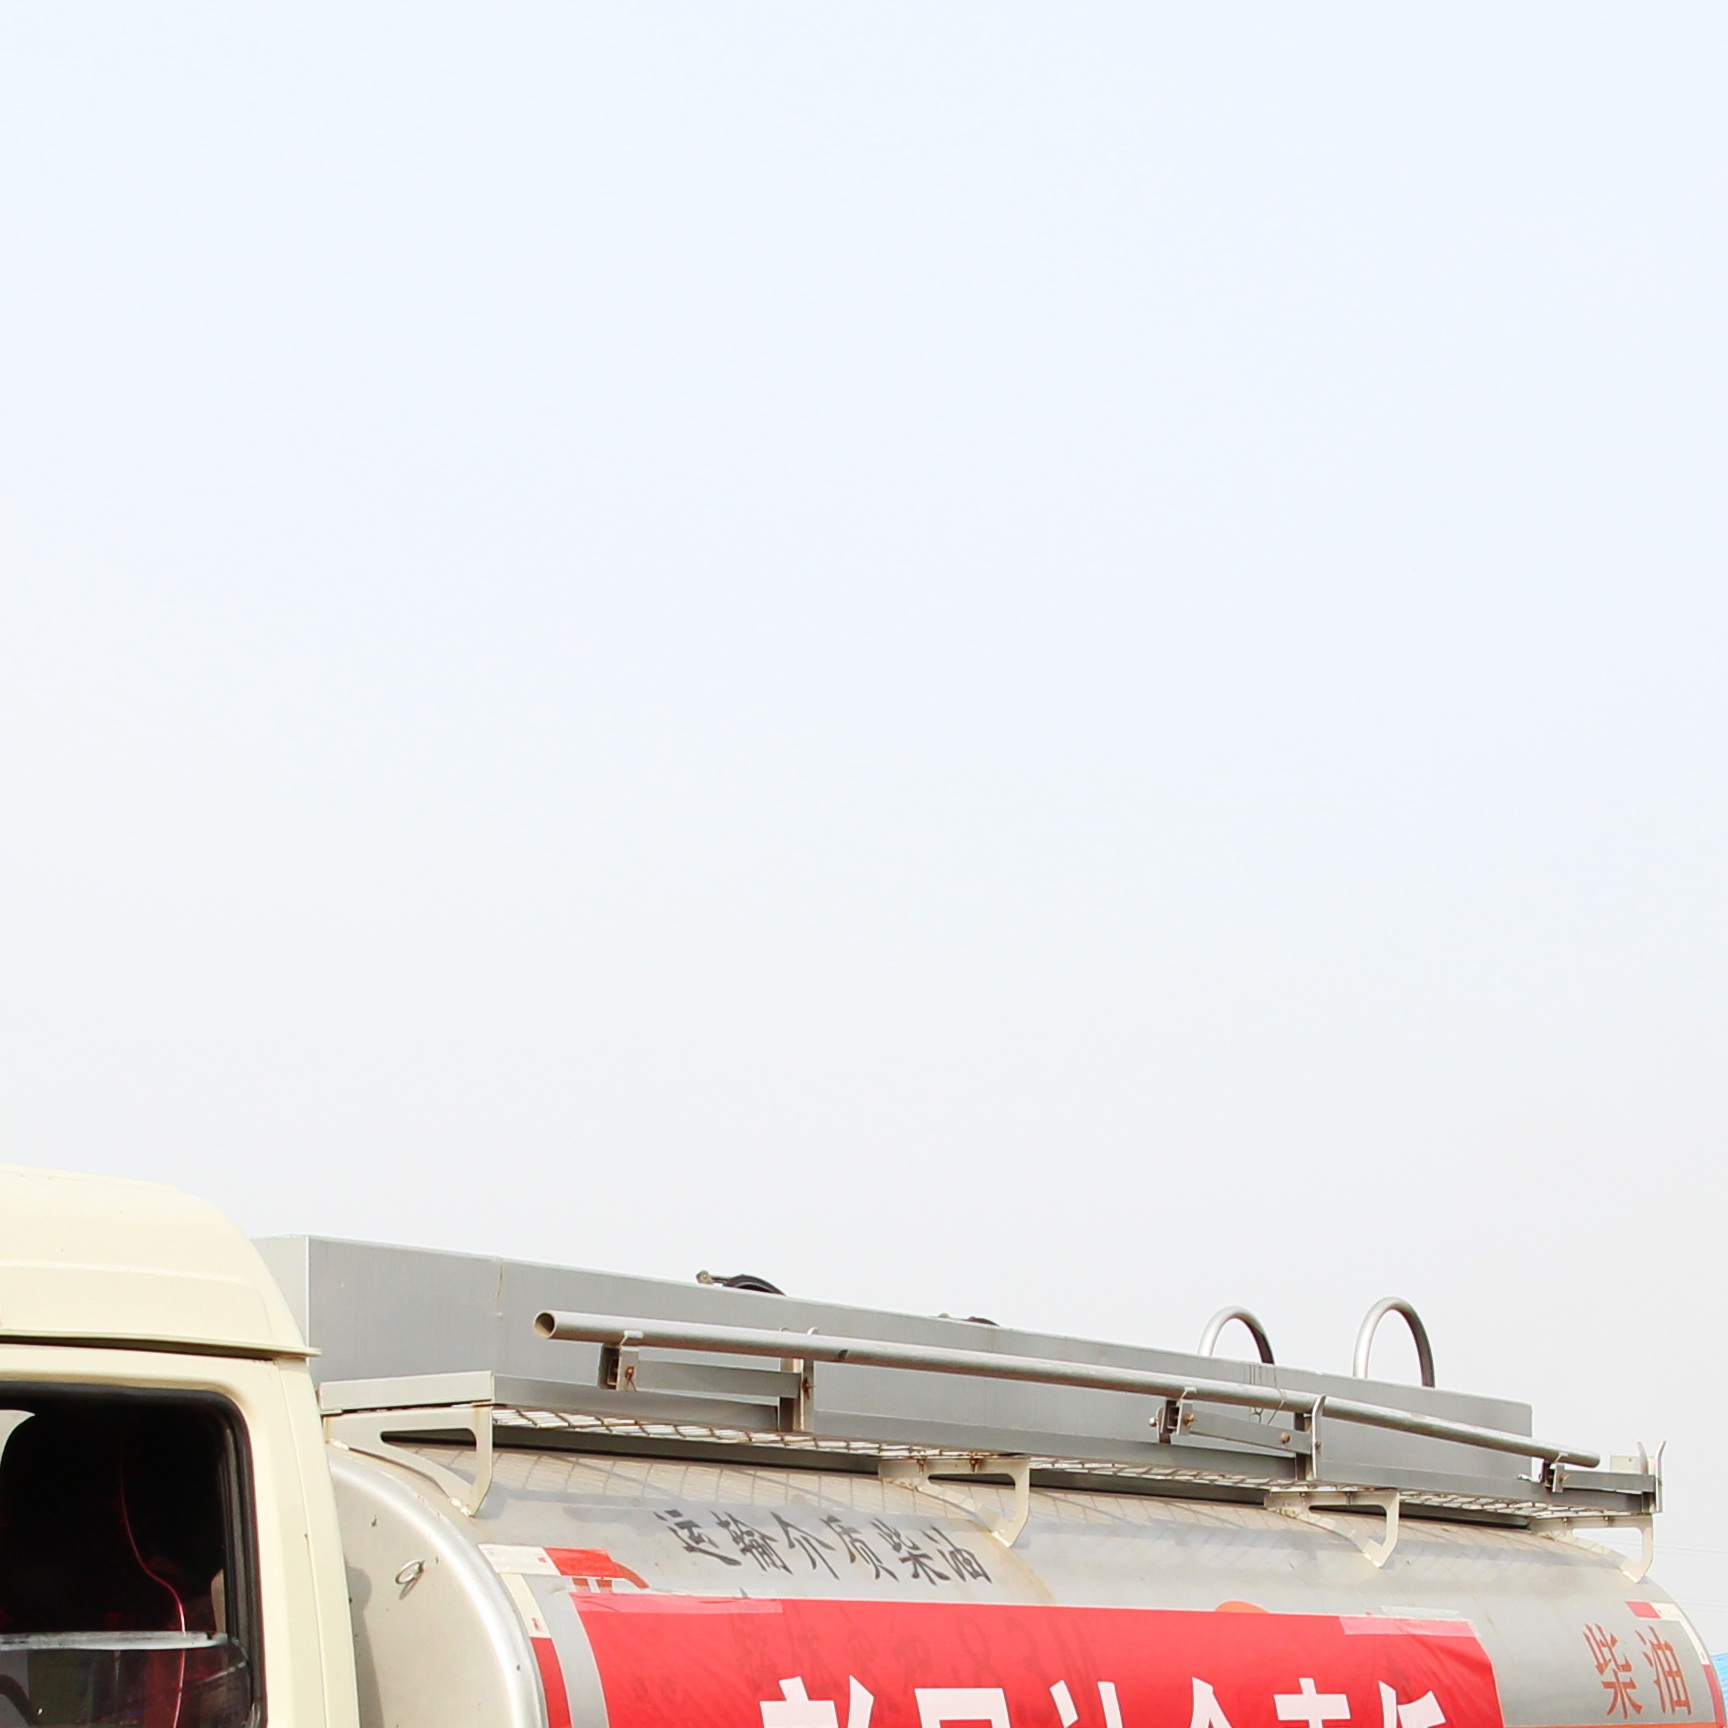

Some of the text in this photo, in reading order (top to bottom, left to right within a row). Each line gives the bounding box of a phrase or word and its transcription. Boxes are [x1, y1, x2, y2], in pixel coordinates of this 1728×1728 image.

[653, 1509, 992, 1585] 运输介质柴油
[1583, 1623, 1692, 1720] 柴油
